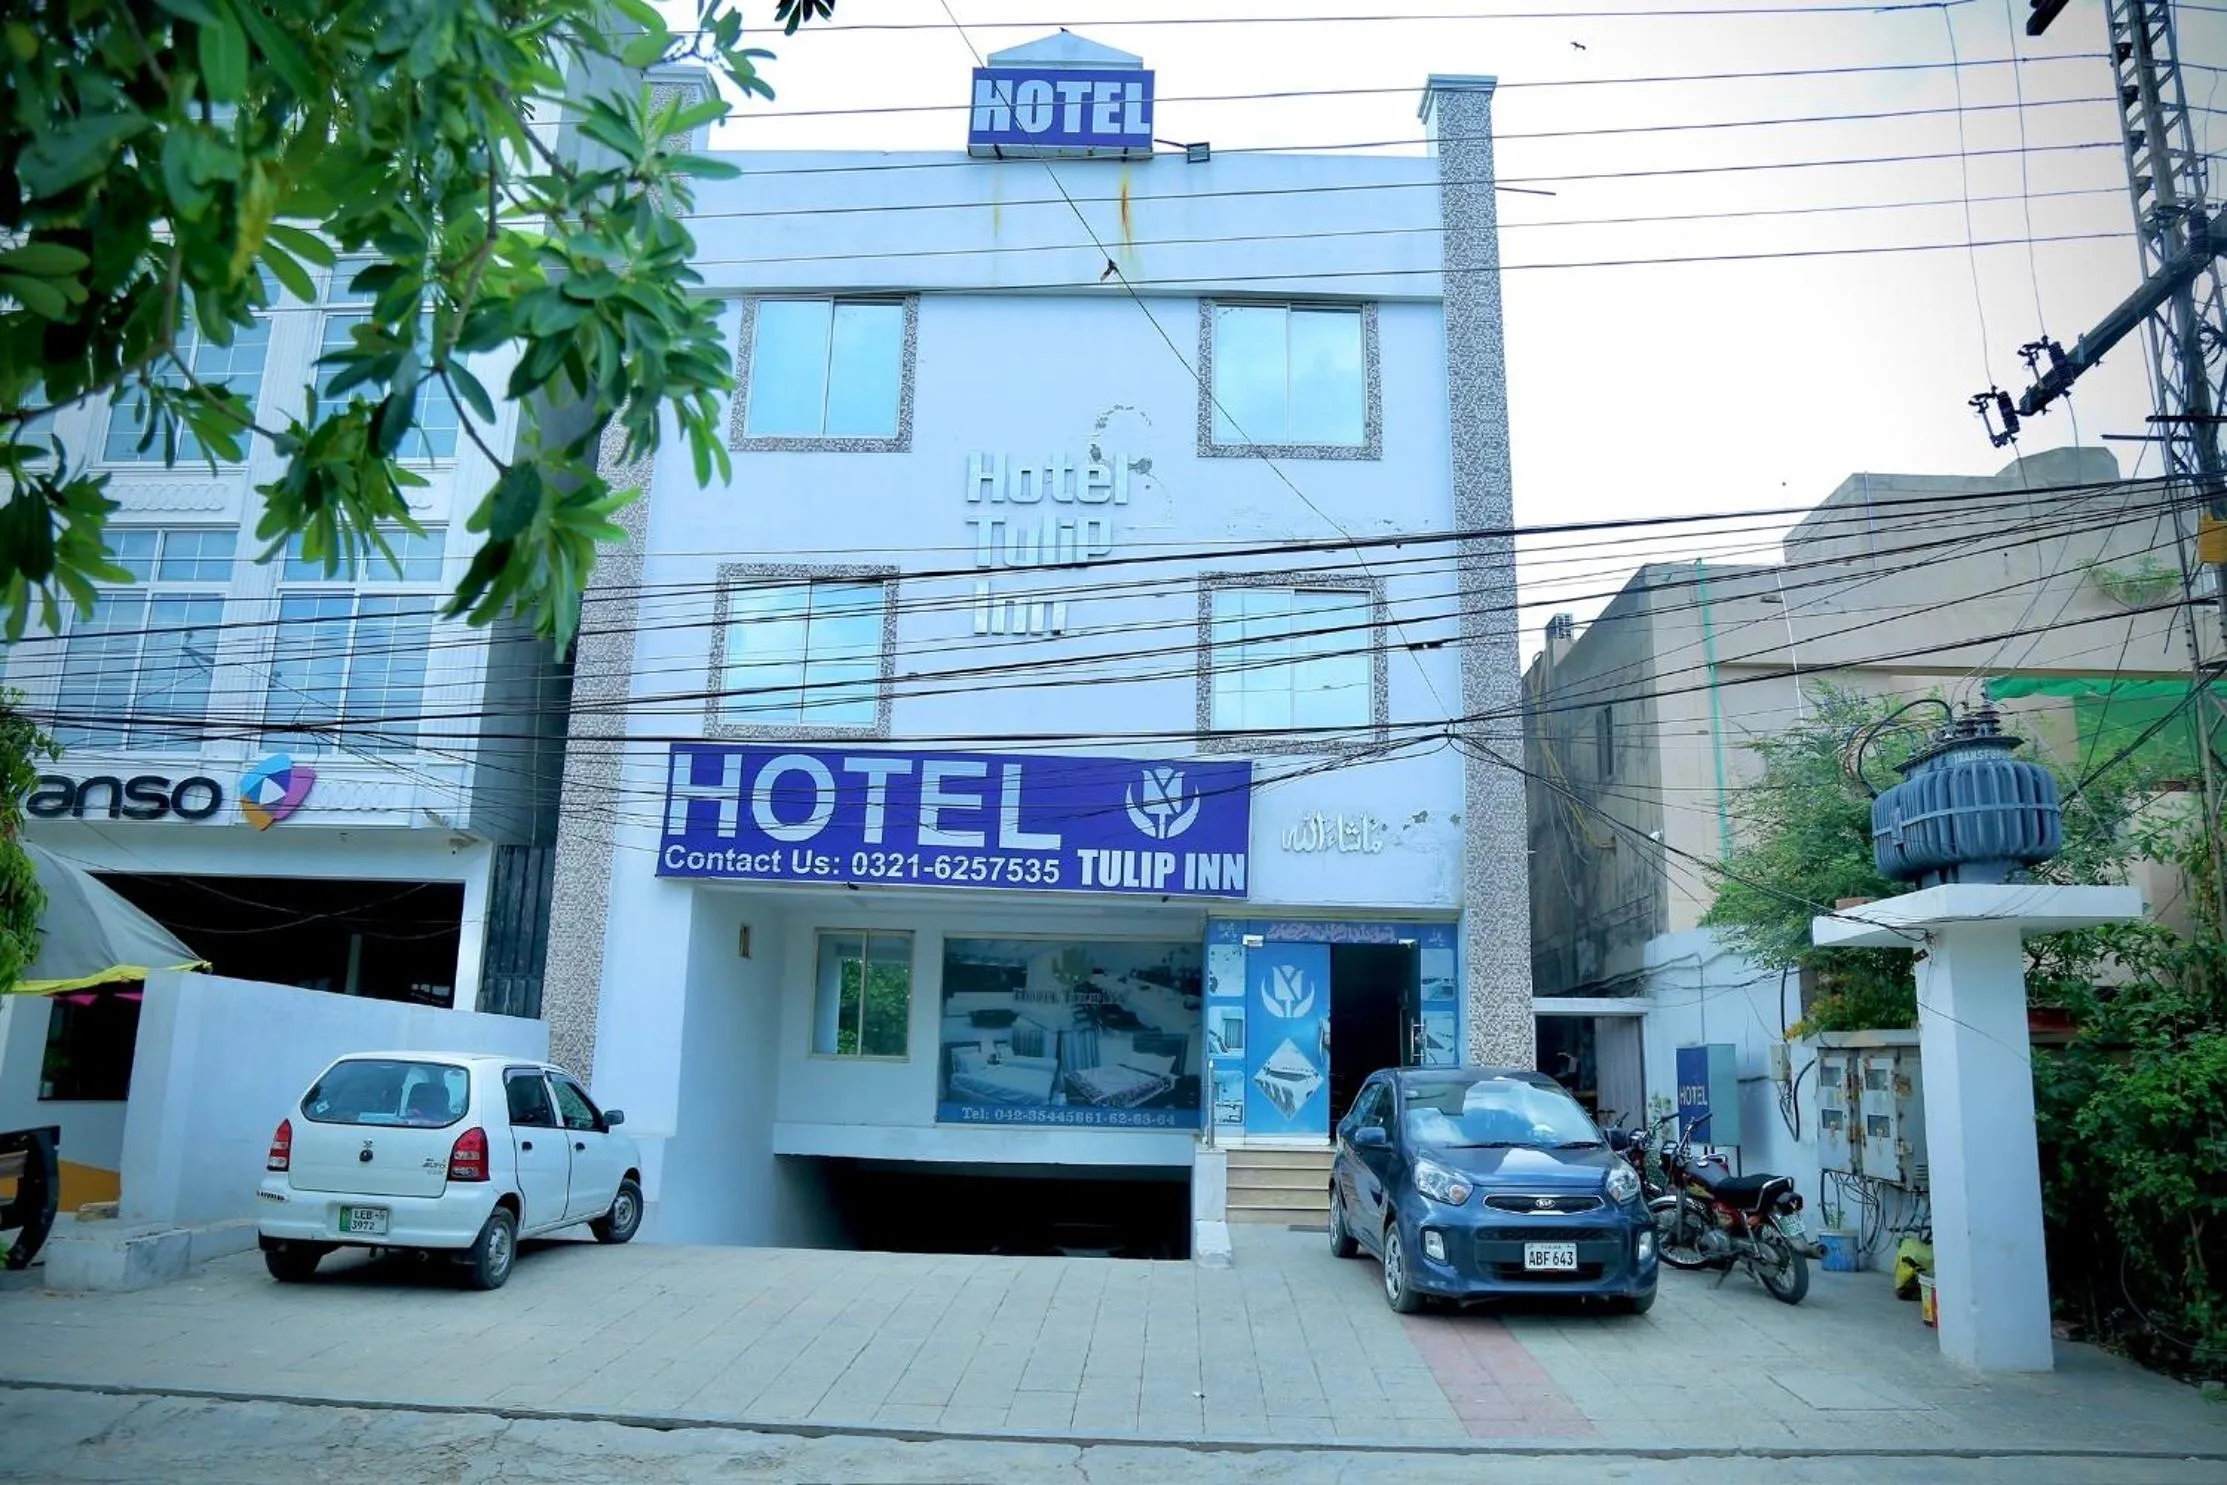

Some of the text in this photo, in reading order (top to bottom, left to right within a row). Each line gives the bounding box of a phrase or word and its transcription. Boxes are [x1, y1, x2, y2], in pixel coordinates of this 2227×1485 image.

[973, 79, 1151, 134] HOTEL
[966, 452, 1128, 505] Hotel
[974, 580, 1068, 636] Inn
[667, 751, 1061, 850] HOTEL
[664, 844, 1060, 884] Contact Us: 0321-6257535
[1077, 848, 1246, 891] TULIP INN
[961, 1107, 990, 1121] Tel:
[1680, 1085, 1708, 1105] HOTEL
[1529, 1252, 1573, 1266] ABF 643
